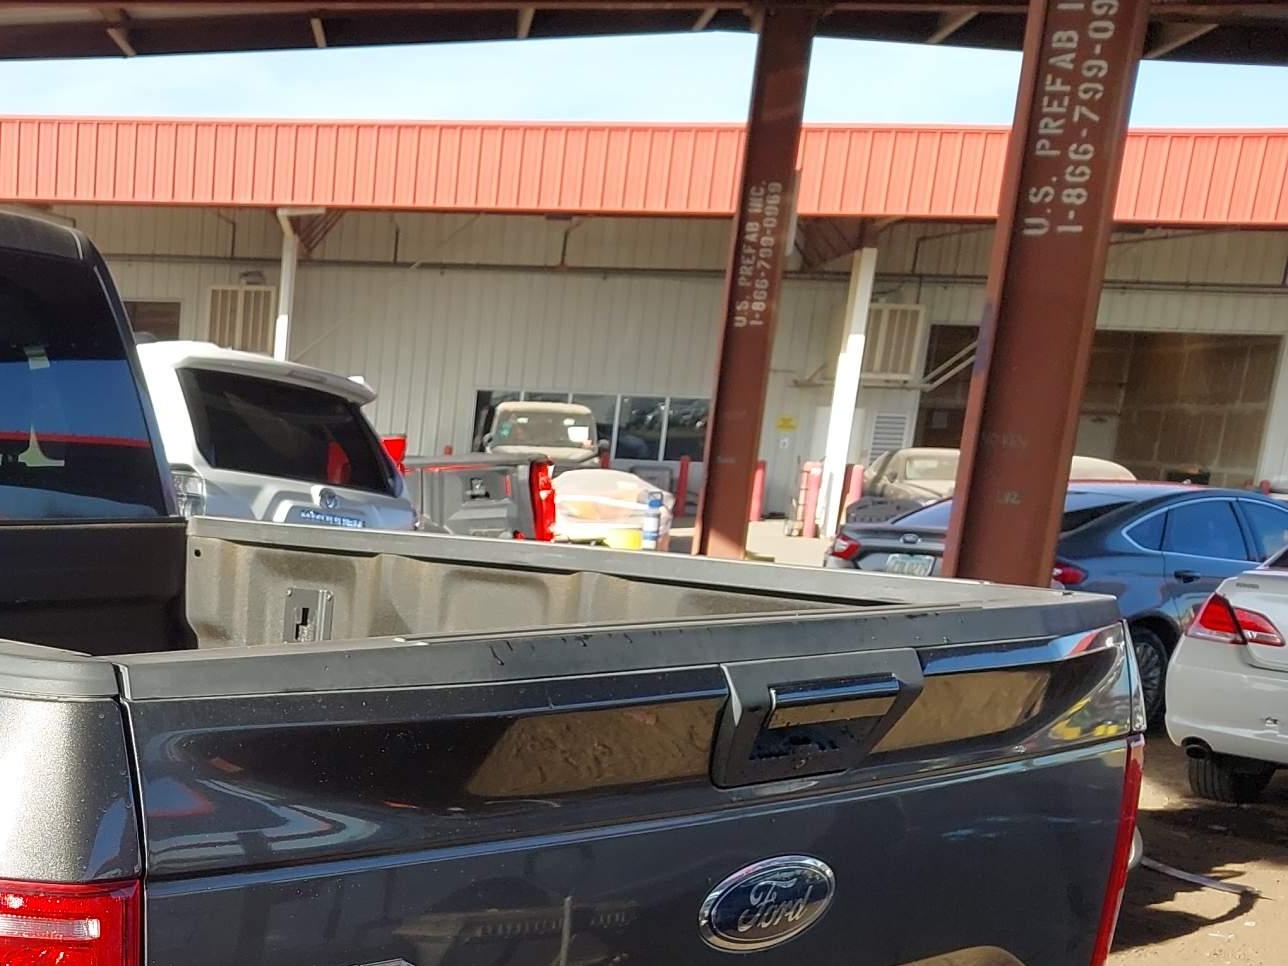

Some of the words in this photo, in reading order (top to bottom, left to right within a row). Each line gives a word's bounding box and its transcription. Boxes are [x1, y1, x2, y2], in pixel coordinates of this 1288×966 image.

[1035, 30, 1080, 156] PREFAB
[747, 180, 767, 214] INC.
[1022, 176, 1058, 236] U.S.
[737, 221, 760, 286] PREFAB
[734, 295, 750, 328] U.S.
[738, 878, 813, 932] Ford
